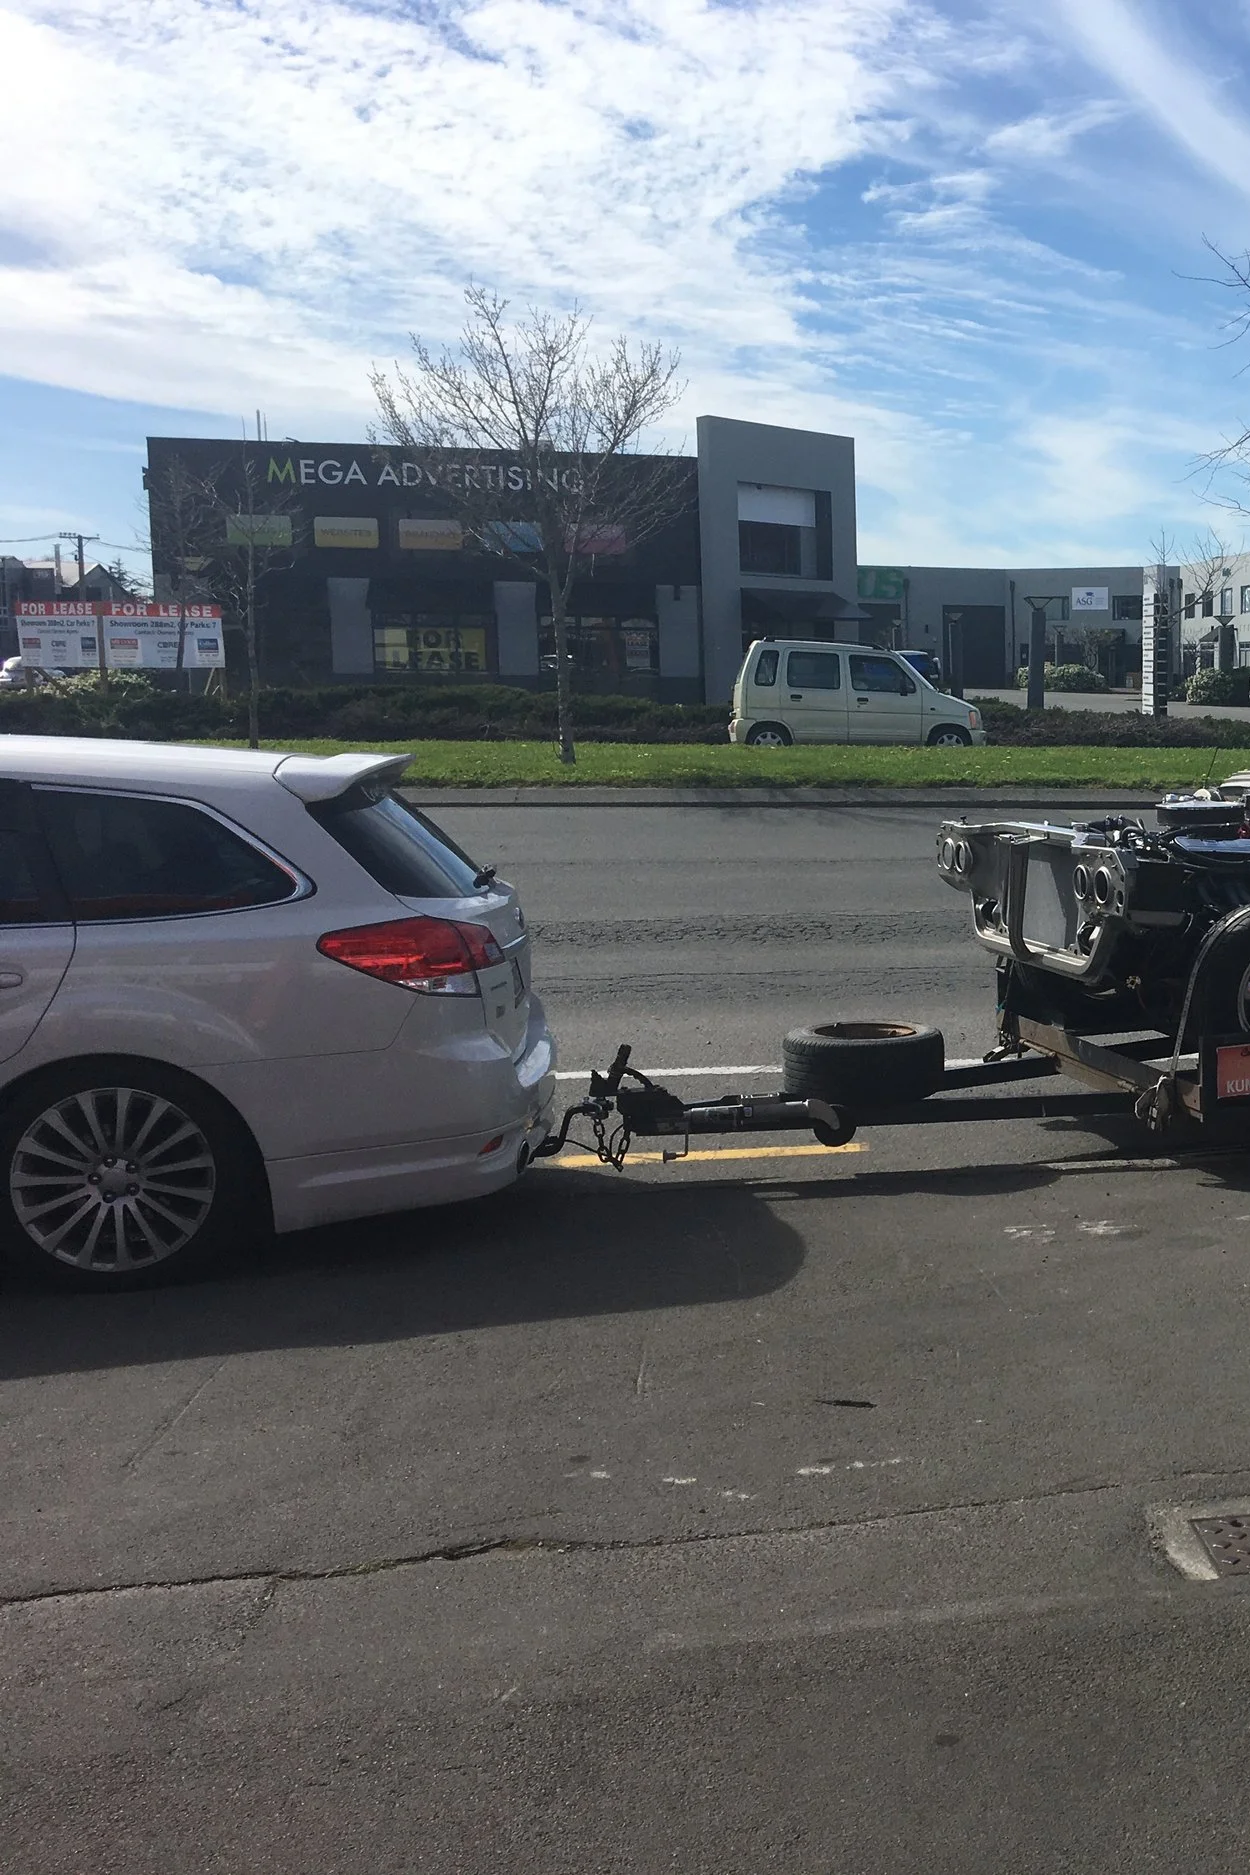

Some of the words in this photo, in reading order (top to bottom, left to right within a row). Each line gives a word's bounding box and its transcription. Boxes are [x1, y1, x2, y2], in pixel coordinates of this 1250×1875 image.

[267, 457, 367, 485] MEGA
[377, 462, 585, 493] ADVERTISING
[1077, 597, 1093, 606] ASG
[21, 603, 46, 614] FOR
[53, 603, 93, 615] LEASE
[112, 604, 148, 616] FOR
[160, 604, 213, 617] LEASE
[406, 629, 463, 648] FOR
